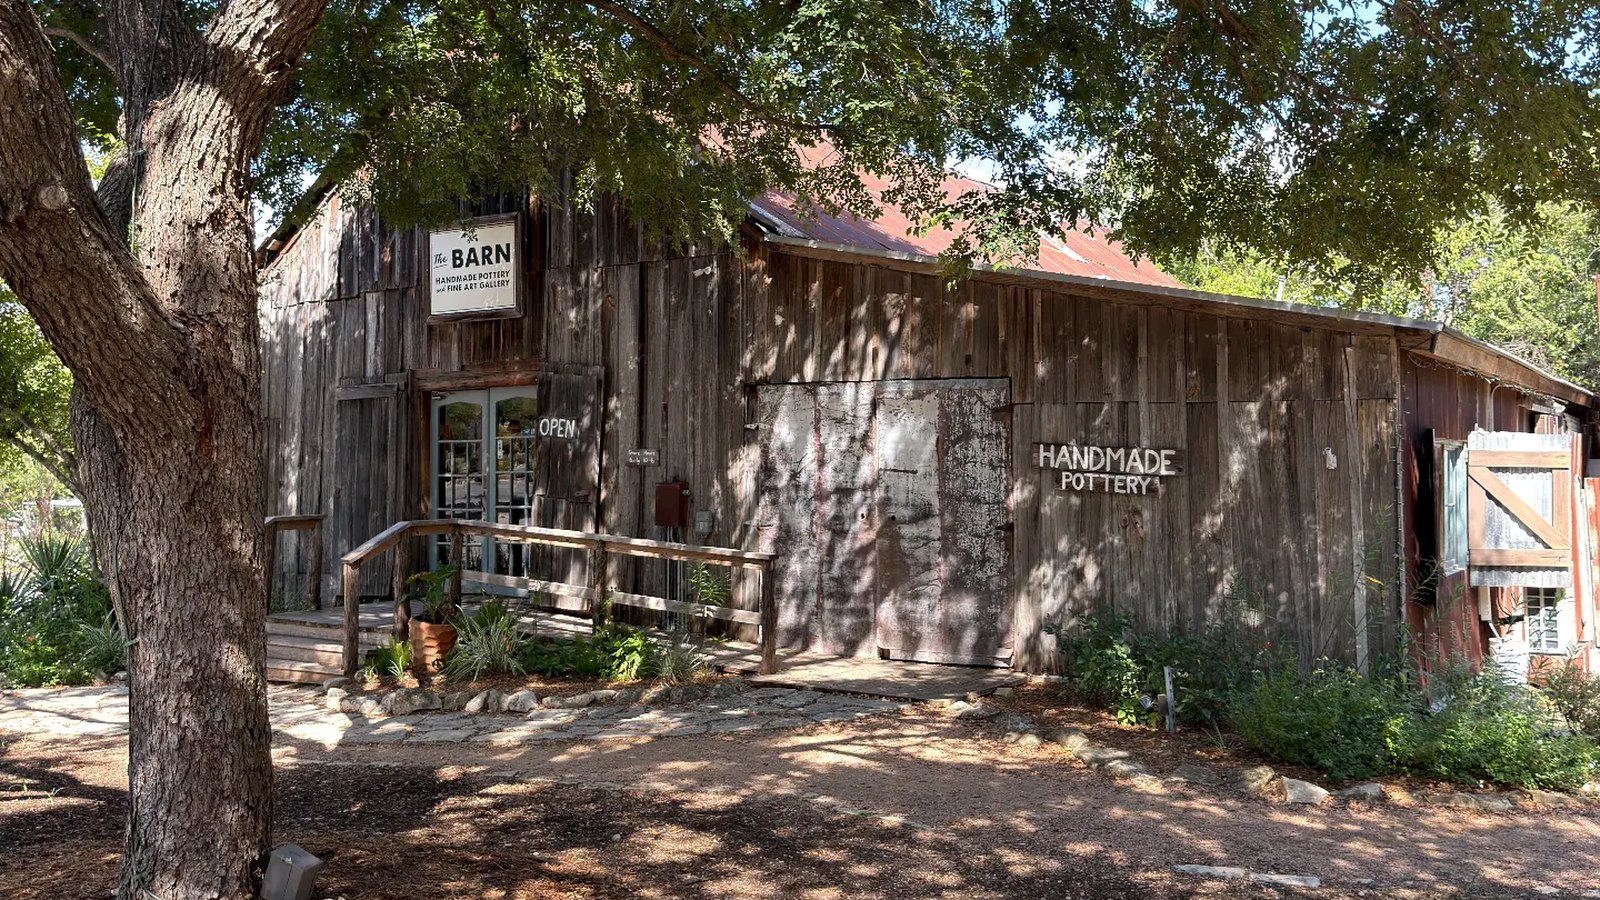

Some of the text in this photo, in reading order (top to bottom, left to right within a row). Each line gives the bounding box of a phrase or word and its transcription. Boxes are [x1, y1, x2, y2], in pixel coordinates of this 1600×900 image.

[433, 243, 511, 269] The BARN
[436, 270, 510, 284] HANDMADE POTTERY
[447, 284, 462, 292] FINE
[464, 282, 478, 290] ART
[480, 280, 510, 289] GALLERY
[539, 418, 576, 438] OPEN
[1039, 444, 1176, 476] HANDMADE
[1061, 471, 1151, 495] POTTERY
